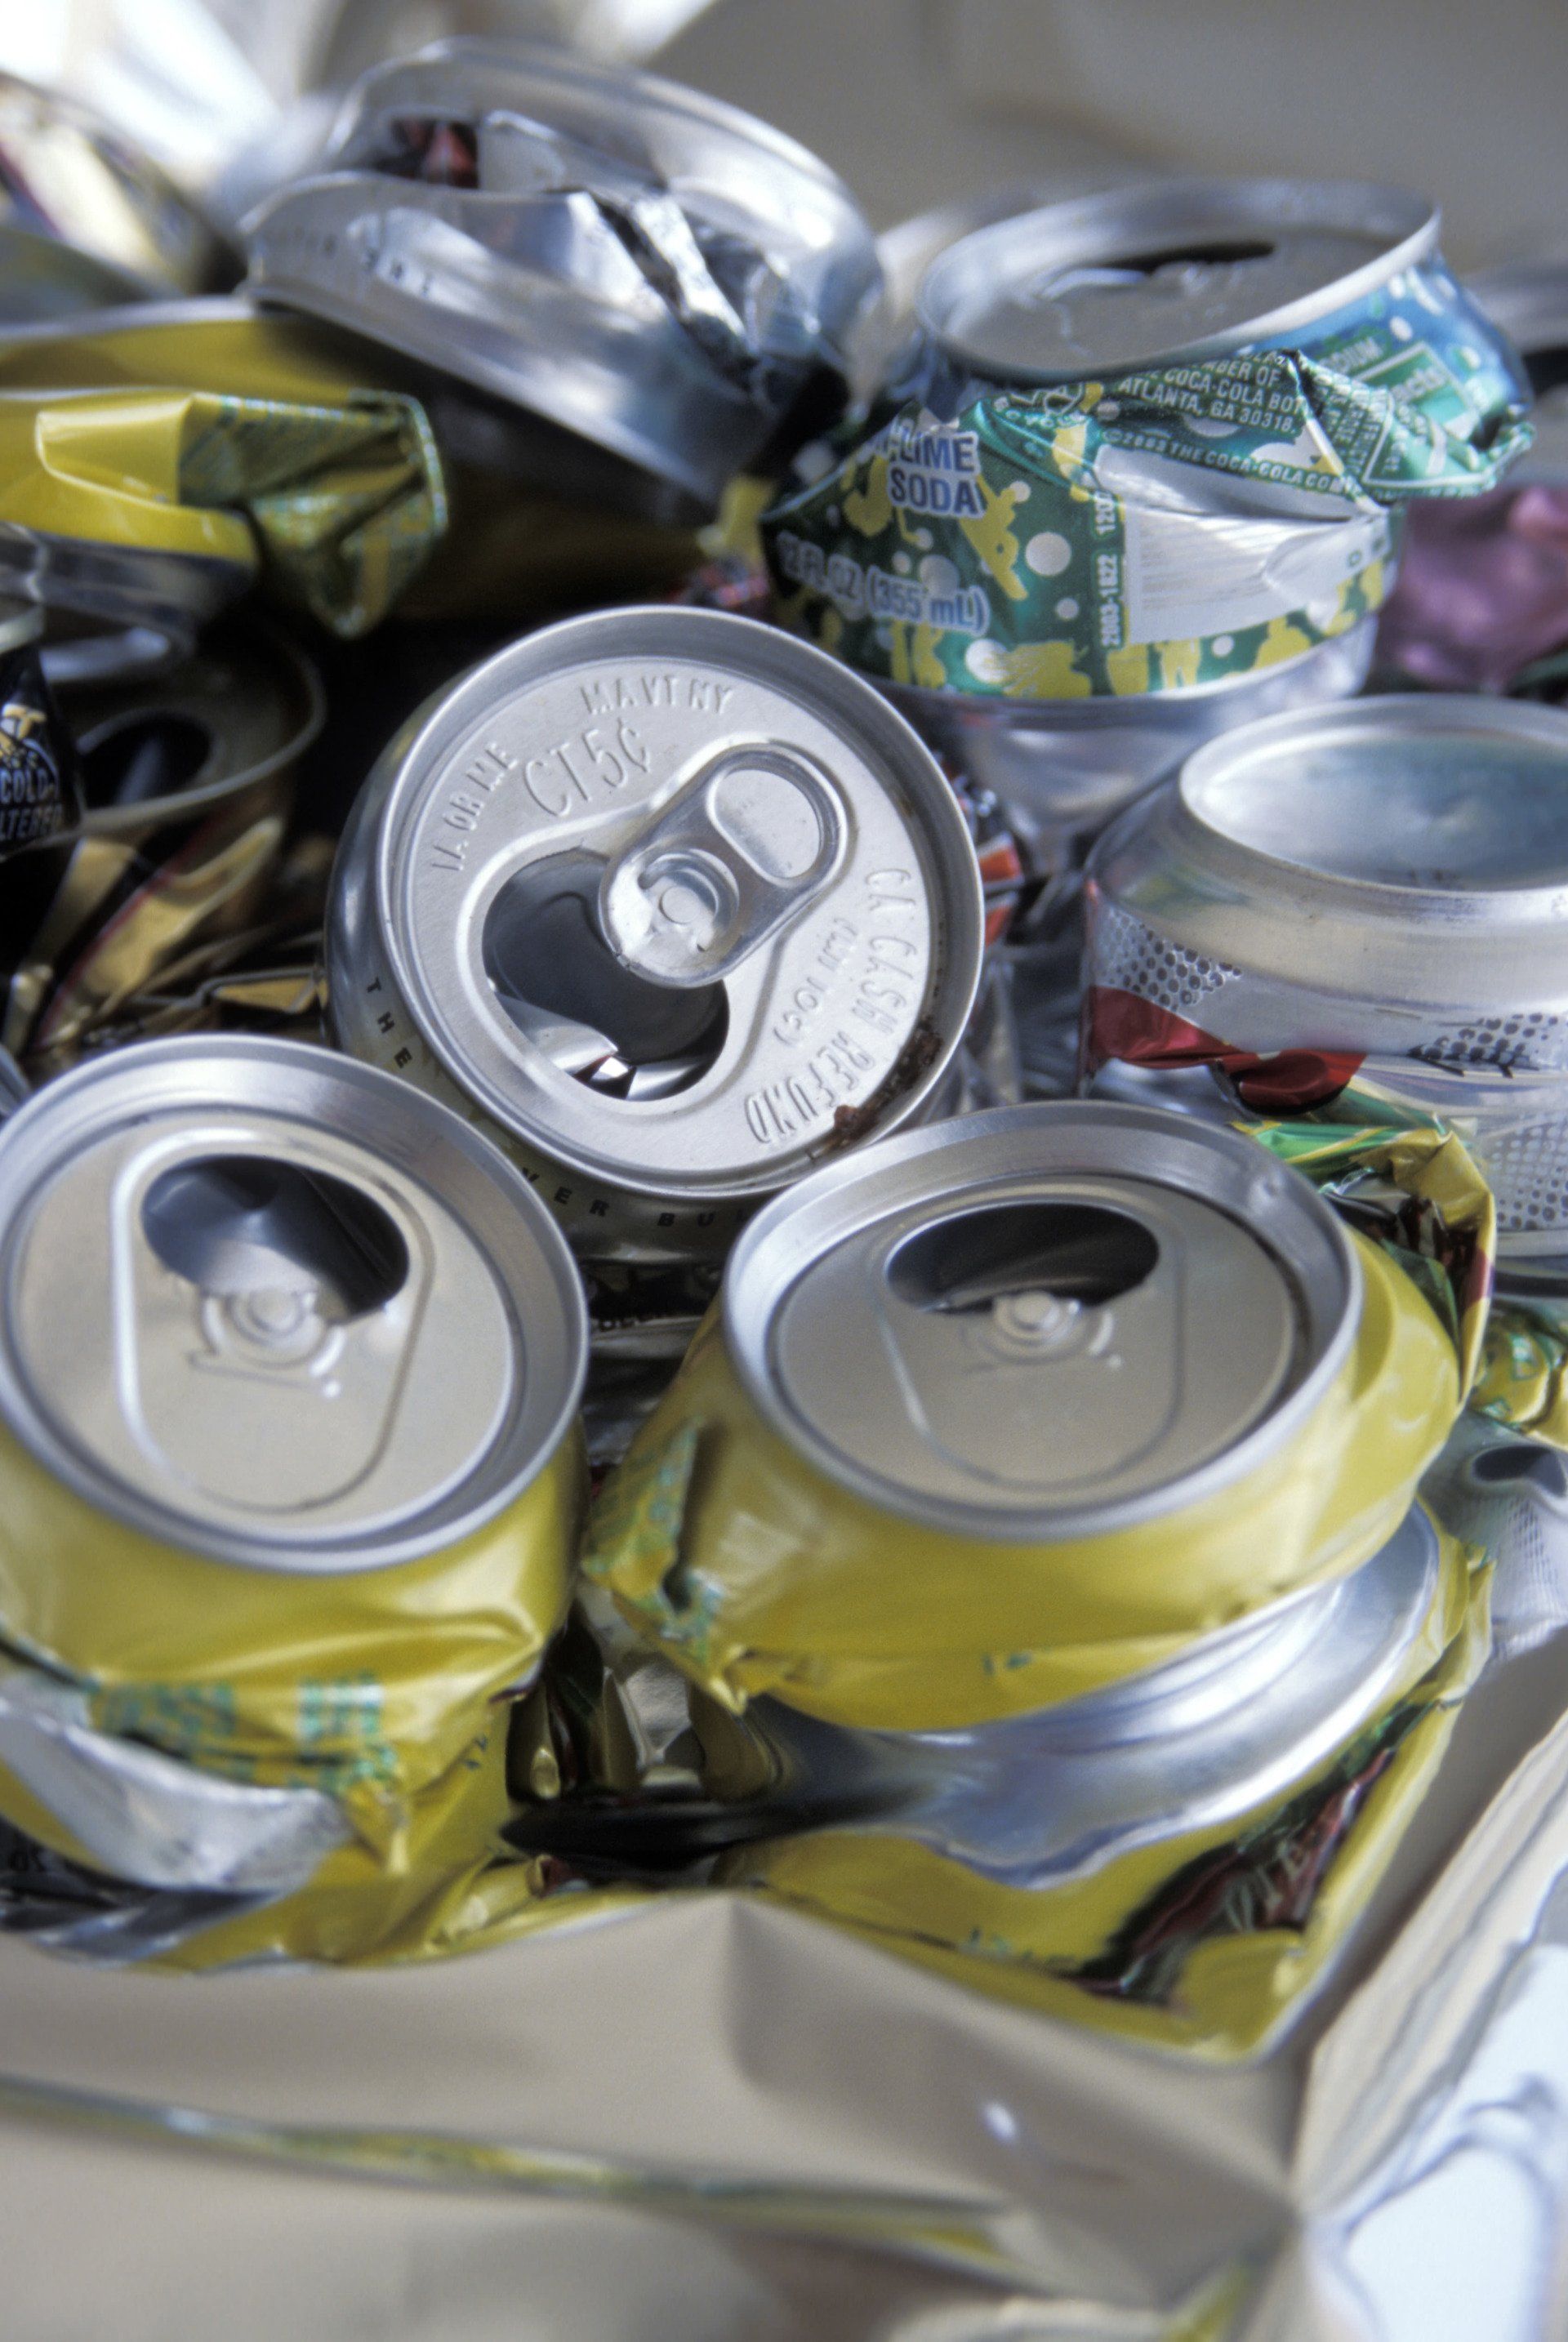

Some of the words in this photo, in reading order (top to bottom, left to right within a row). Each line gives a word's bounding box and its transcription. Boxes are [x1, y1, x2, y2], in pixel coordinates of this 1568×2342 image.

[1163, 367, 1265, 406] COCA-COLA
[1256, 366, 1282, 388] OF
[1117, 376, 1204, 416] ATLANTA,
[1209, 398, 1236, 421] GA
[1239, 407, 1296, 435] 30318.
[1169, 439, 1201, 461] THE
[1204, 449, 1304, 486] COCA-COLA
[889, 467, 979, 516] SODA
[868, 568, 921, 620] (355
[929, 589, 988, 634] mL)
[688, 677, 736, 715] NY
[852, 936, 920, 1035] CASH
[366, 977, 412, 1070] THE
[744, 1030, 876, 1144] REFUND
